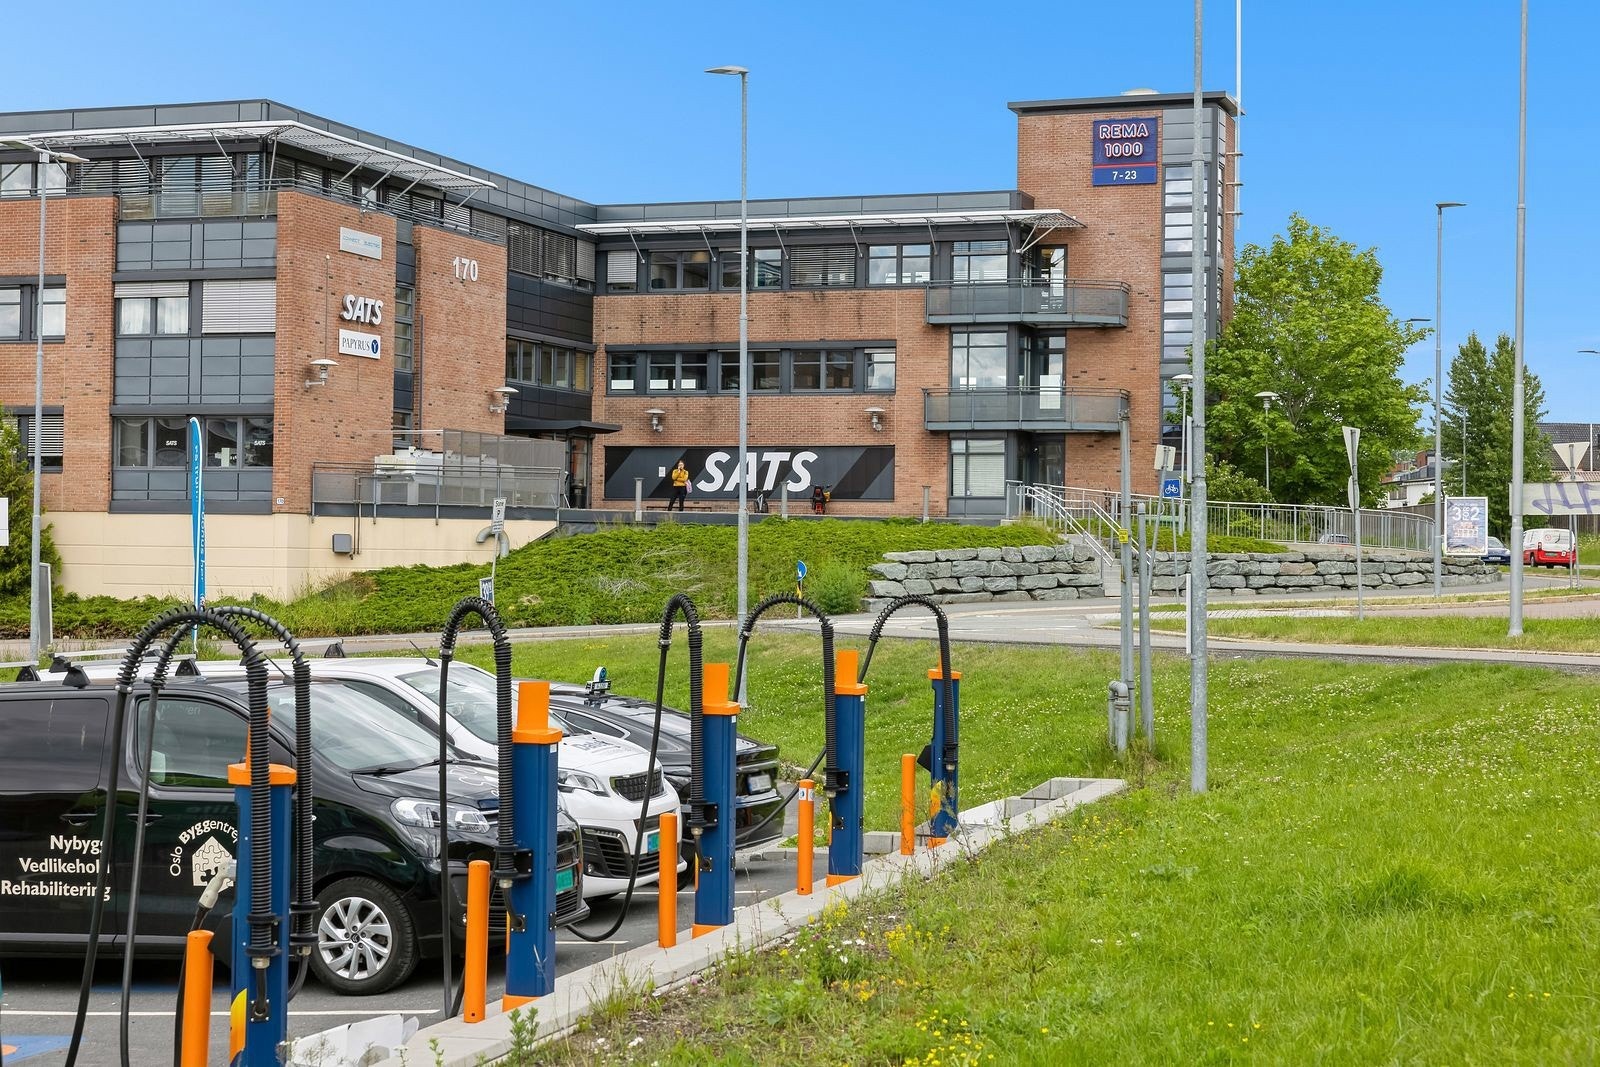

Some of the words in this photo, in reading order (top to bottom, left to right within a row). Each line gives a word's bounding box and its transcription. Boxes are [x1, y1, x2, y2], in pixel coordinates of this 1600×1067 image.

[1100, 123, 1148, 139] REMA
[1105, 142, 1143, 157] 1000
[1112, 170, 1137, 181] 7-23
[452, 256, 478, 282] 170
[340, 294, 383, 325] SATS
[342, 337, 370, 351] PAPYRUS
[696, 451, 818, 492] SATS
[1452, 506, 1462, 521] 3
[1470, 506, 1480, 521] 2
[50, 835, 103, 854] Nybyg
[169, 846, 183, 877] Oslo
[178, 819, 239, 845] Byggentre
[19, 857, 110, 874] Vedlikehol
